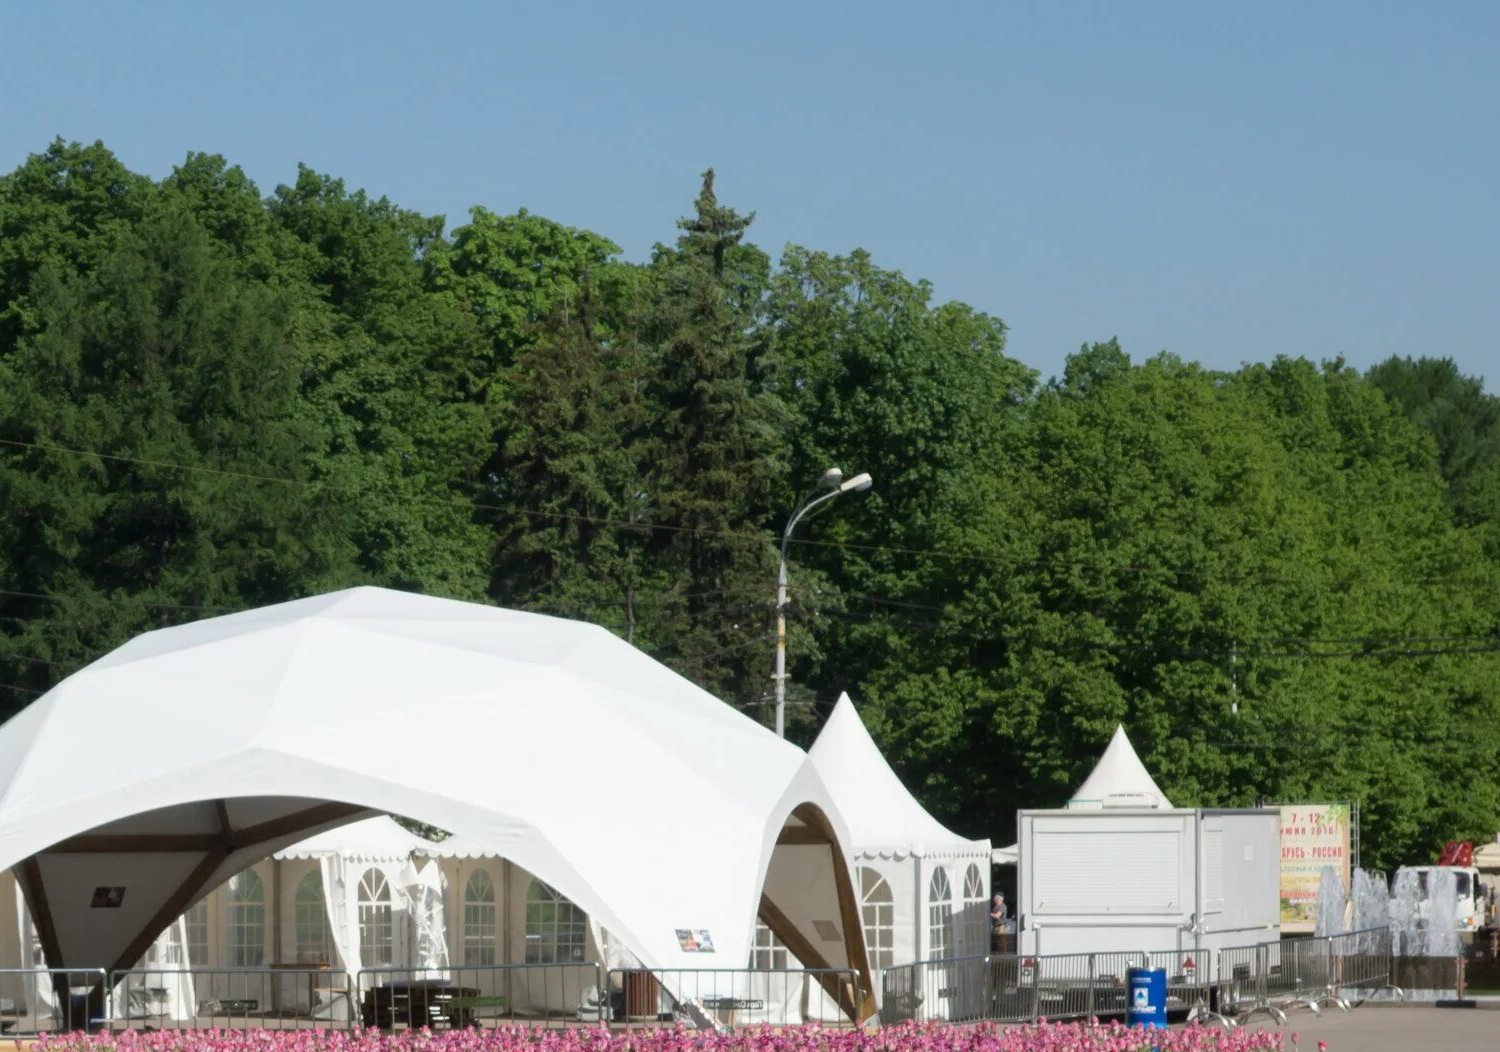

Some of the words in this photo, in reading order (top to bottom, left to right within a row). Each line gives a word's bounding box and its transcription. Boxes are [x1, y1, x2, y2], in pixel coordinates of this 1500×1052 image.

[1292, 813, 1297, 823] 7
[1309, 813, 1320, 823] 12
[1312, 847, 1342, 858] РОССИЯ
